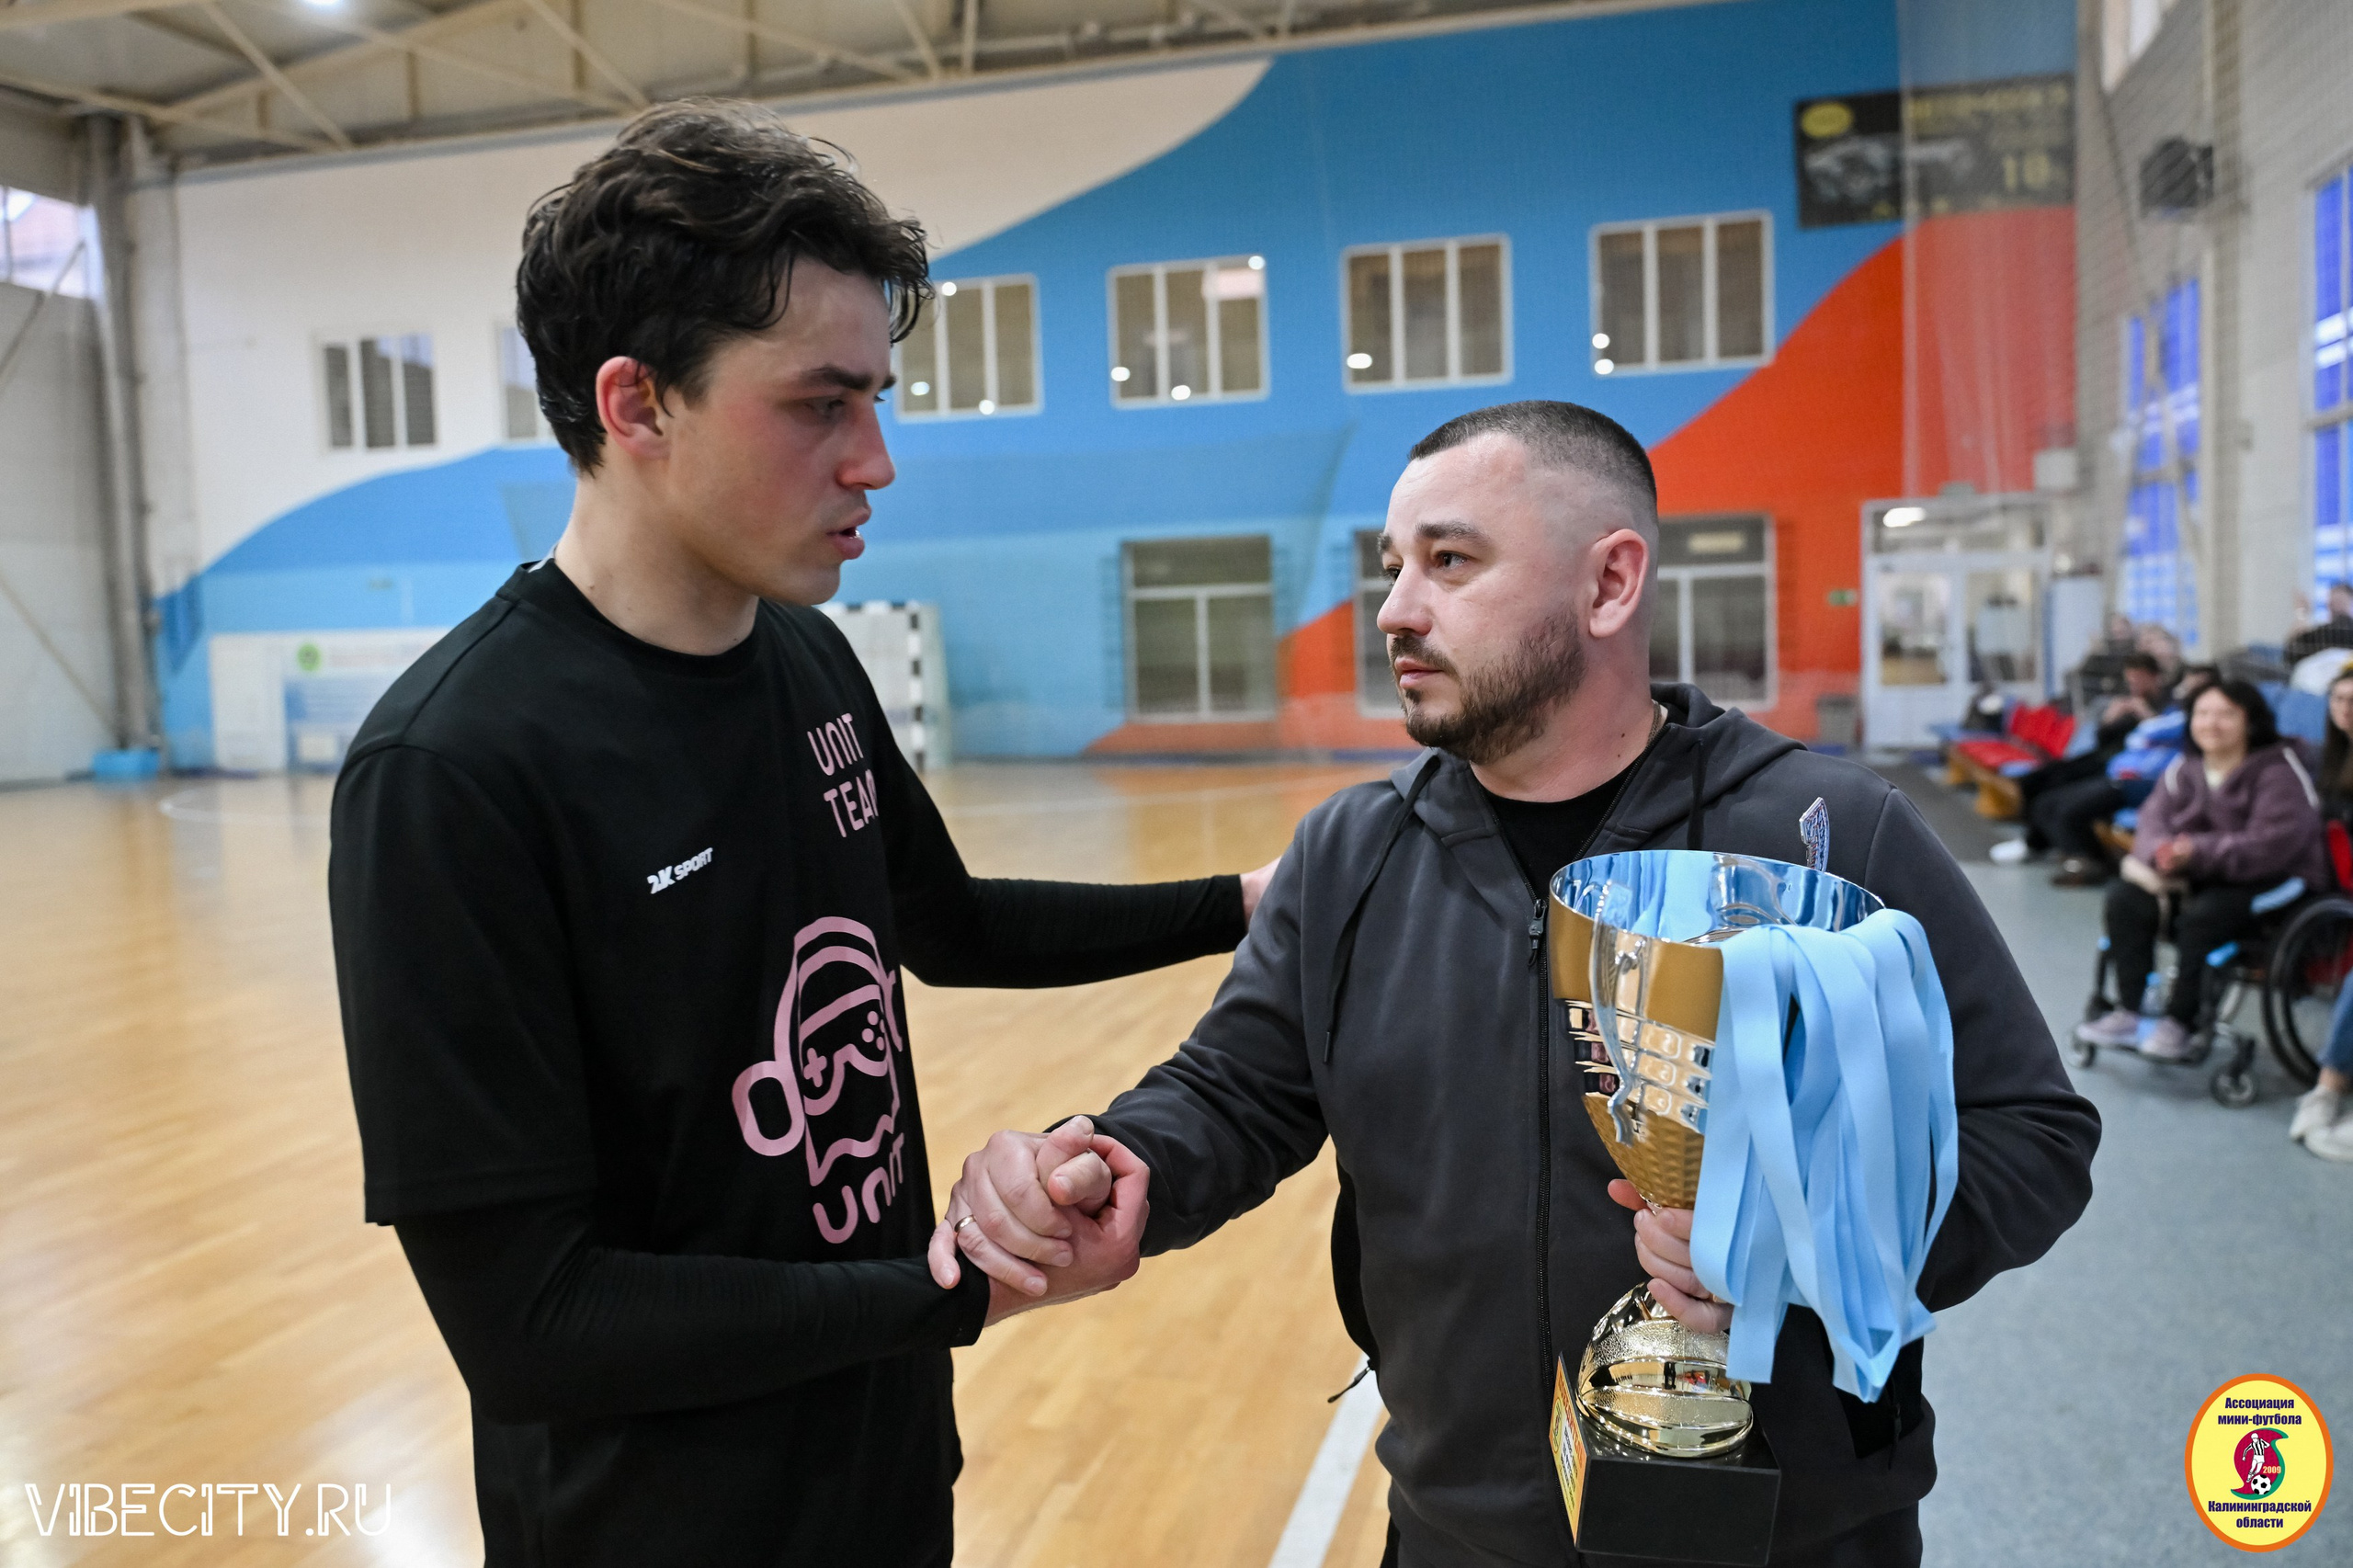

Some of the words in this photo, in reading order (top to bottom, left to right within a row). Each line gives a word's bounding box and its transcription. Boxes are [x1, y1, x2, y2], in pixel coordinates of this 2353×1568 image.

[806, 712, 864, 777] UNIT
[646, 865, 676, 894] 2K
[673, 846, 714, 881] SPORT
[812, 1131, 904, 1244] UNIT
